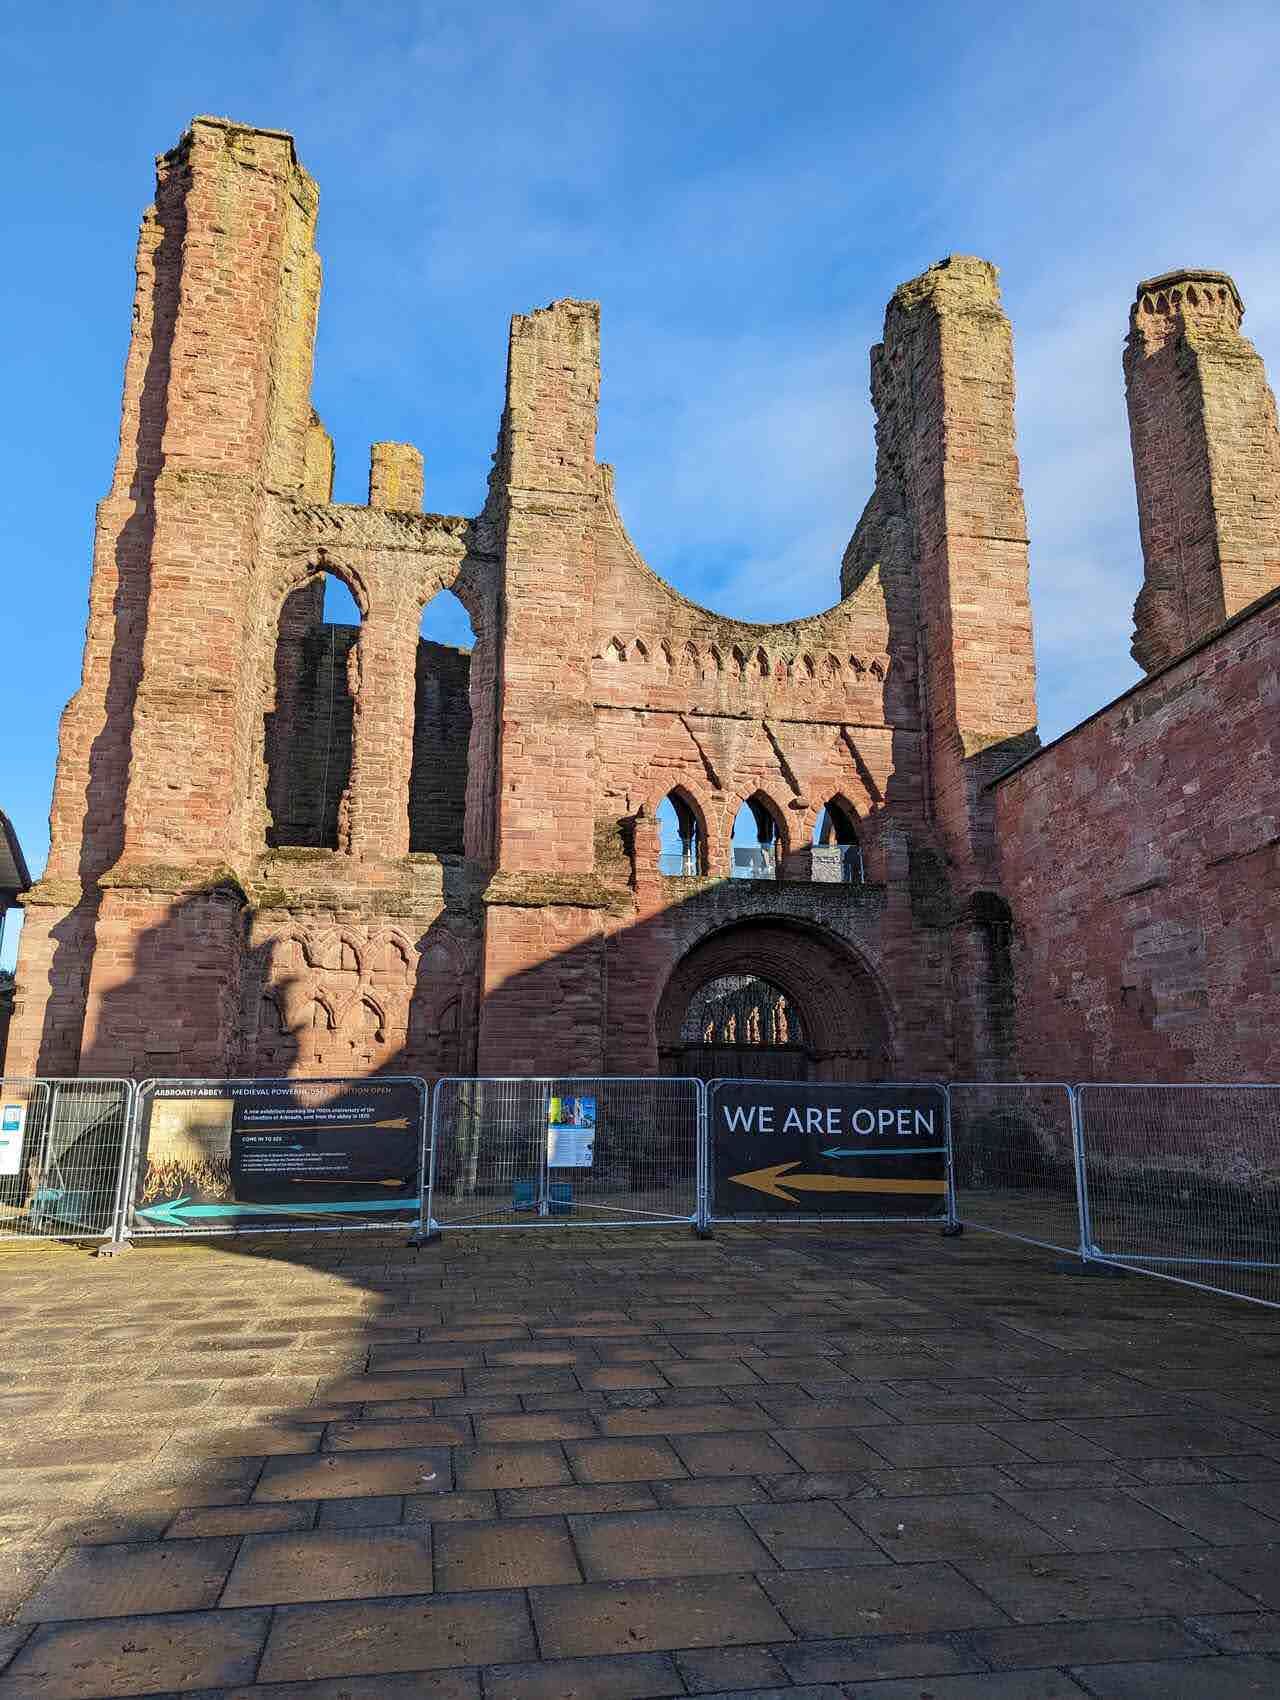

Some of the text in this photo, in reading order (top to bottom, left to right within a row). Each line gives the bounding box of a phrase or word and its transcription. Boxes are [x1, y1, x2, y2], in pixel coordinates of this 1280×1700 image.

[232, 1088, 270, 1096] MEDIEVAL
[722, 1105, 934, 1135] WE ARE OPEN
